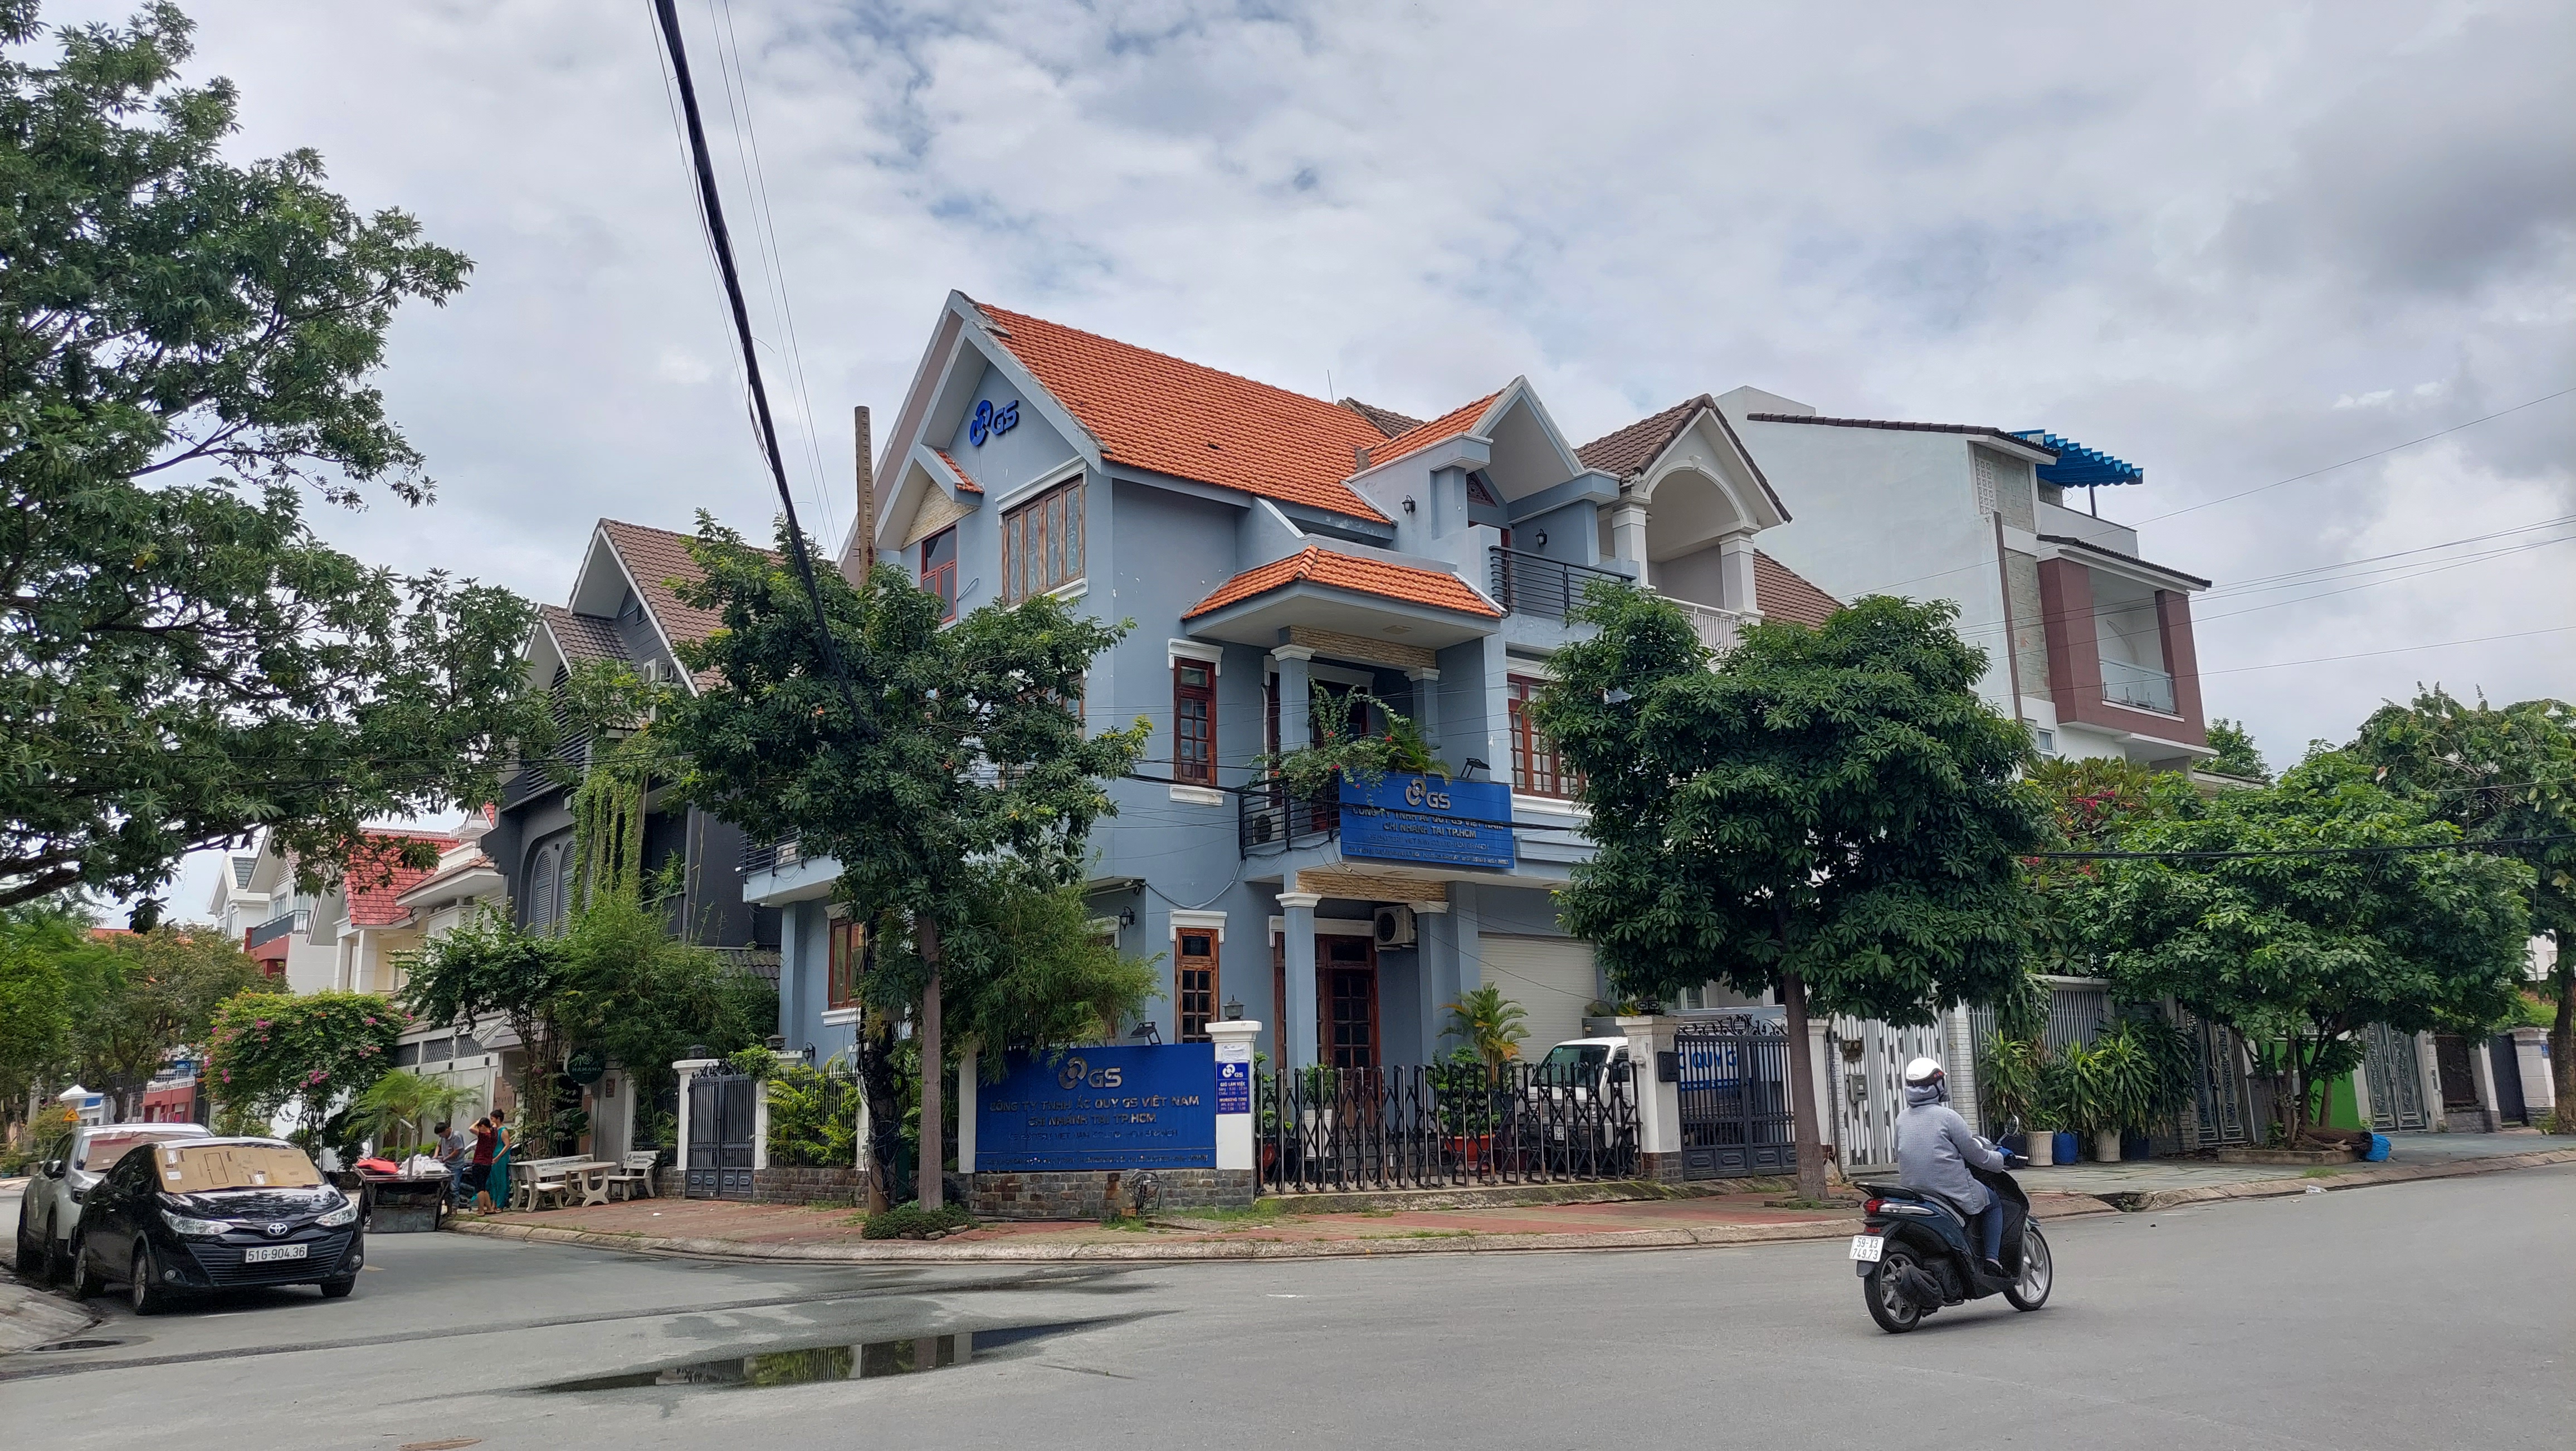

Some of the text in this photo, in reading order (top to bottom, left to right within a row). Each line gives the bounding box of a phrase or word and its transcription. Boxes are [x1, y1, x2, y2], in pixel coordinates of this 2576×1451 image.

[991, 400, 1019, 436] GS
[1426, 792, 1451, 809] GS
[1383, 822, 1397, 831] CHI
[1446, 827, 1476, 839] TP.HCM
[1692, 1051, 1721, 1069] QUY
[1088, 1068, 1122, 1088] GS
[989, 1099, 1018, 1112] CÔNG
[1022, 1101, 1038, 1111] TY
[1041, 1100, 1072, 1111] TNHH
[1095, 1097, 1119, 1109] QUY
[1122, 1097, 1139, 1108] GS
[1141, 1094, 1168, 1108] VIỆT
[1171, 1095, 1199, 1107] NAM
[1028, 1116, 1046, 1126] CHI
[1856, 1238, 1879, 1249] 59-X3
[248, 1247, 305, 1261] 51G-904.36
